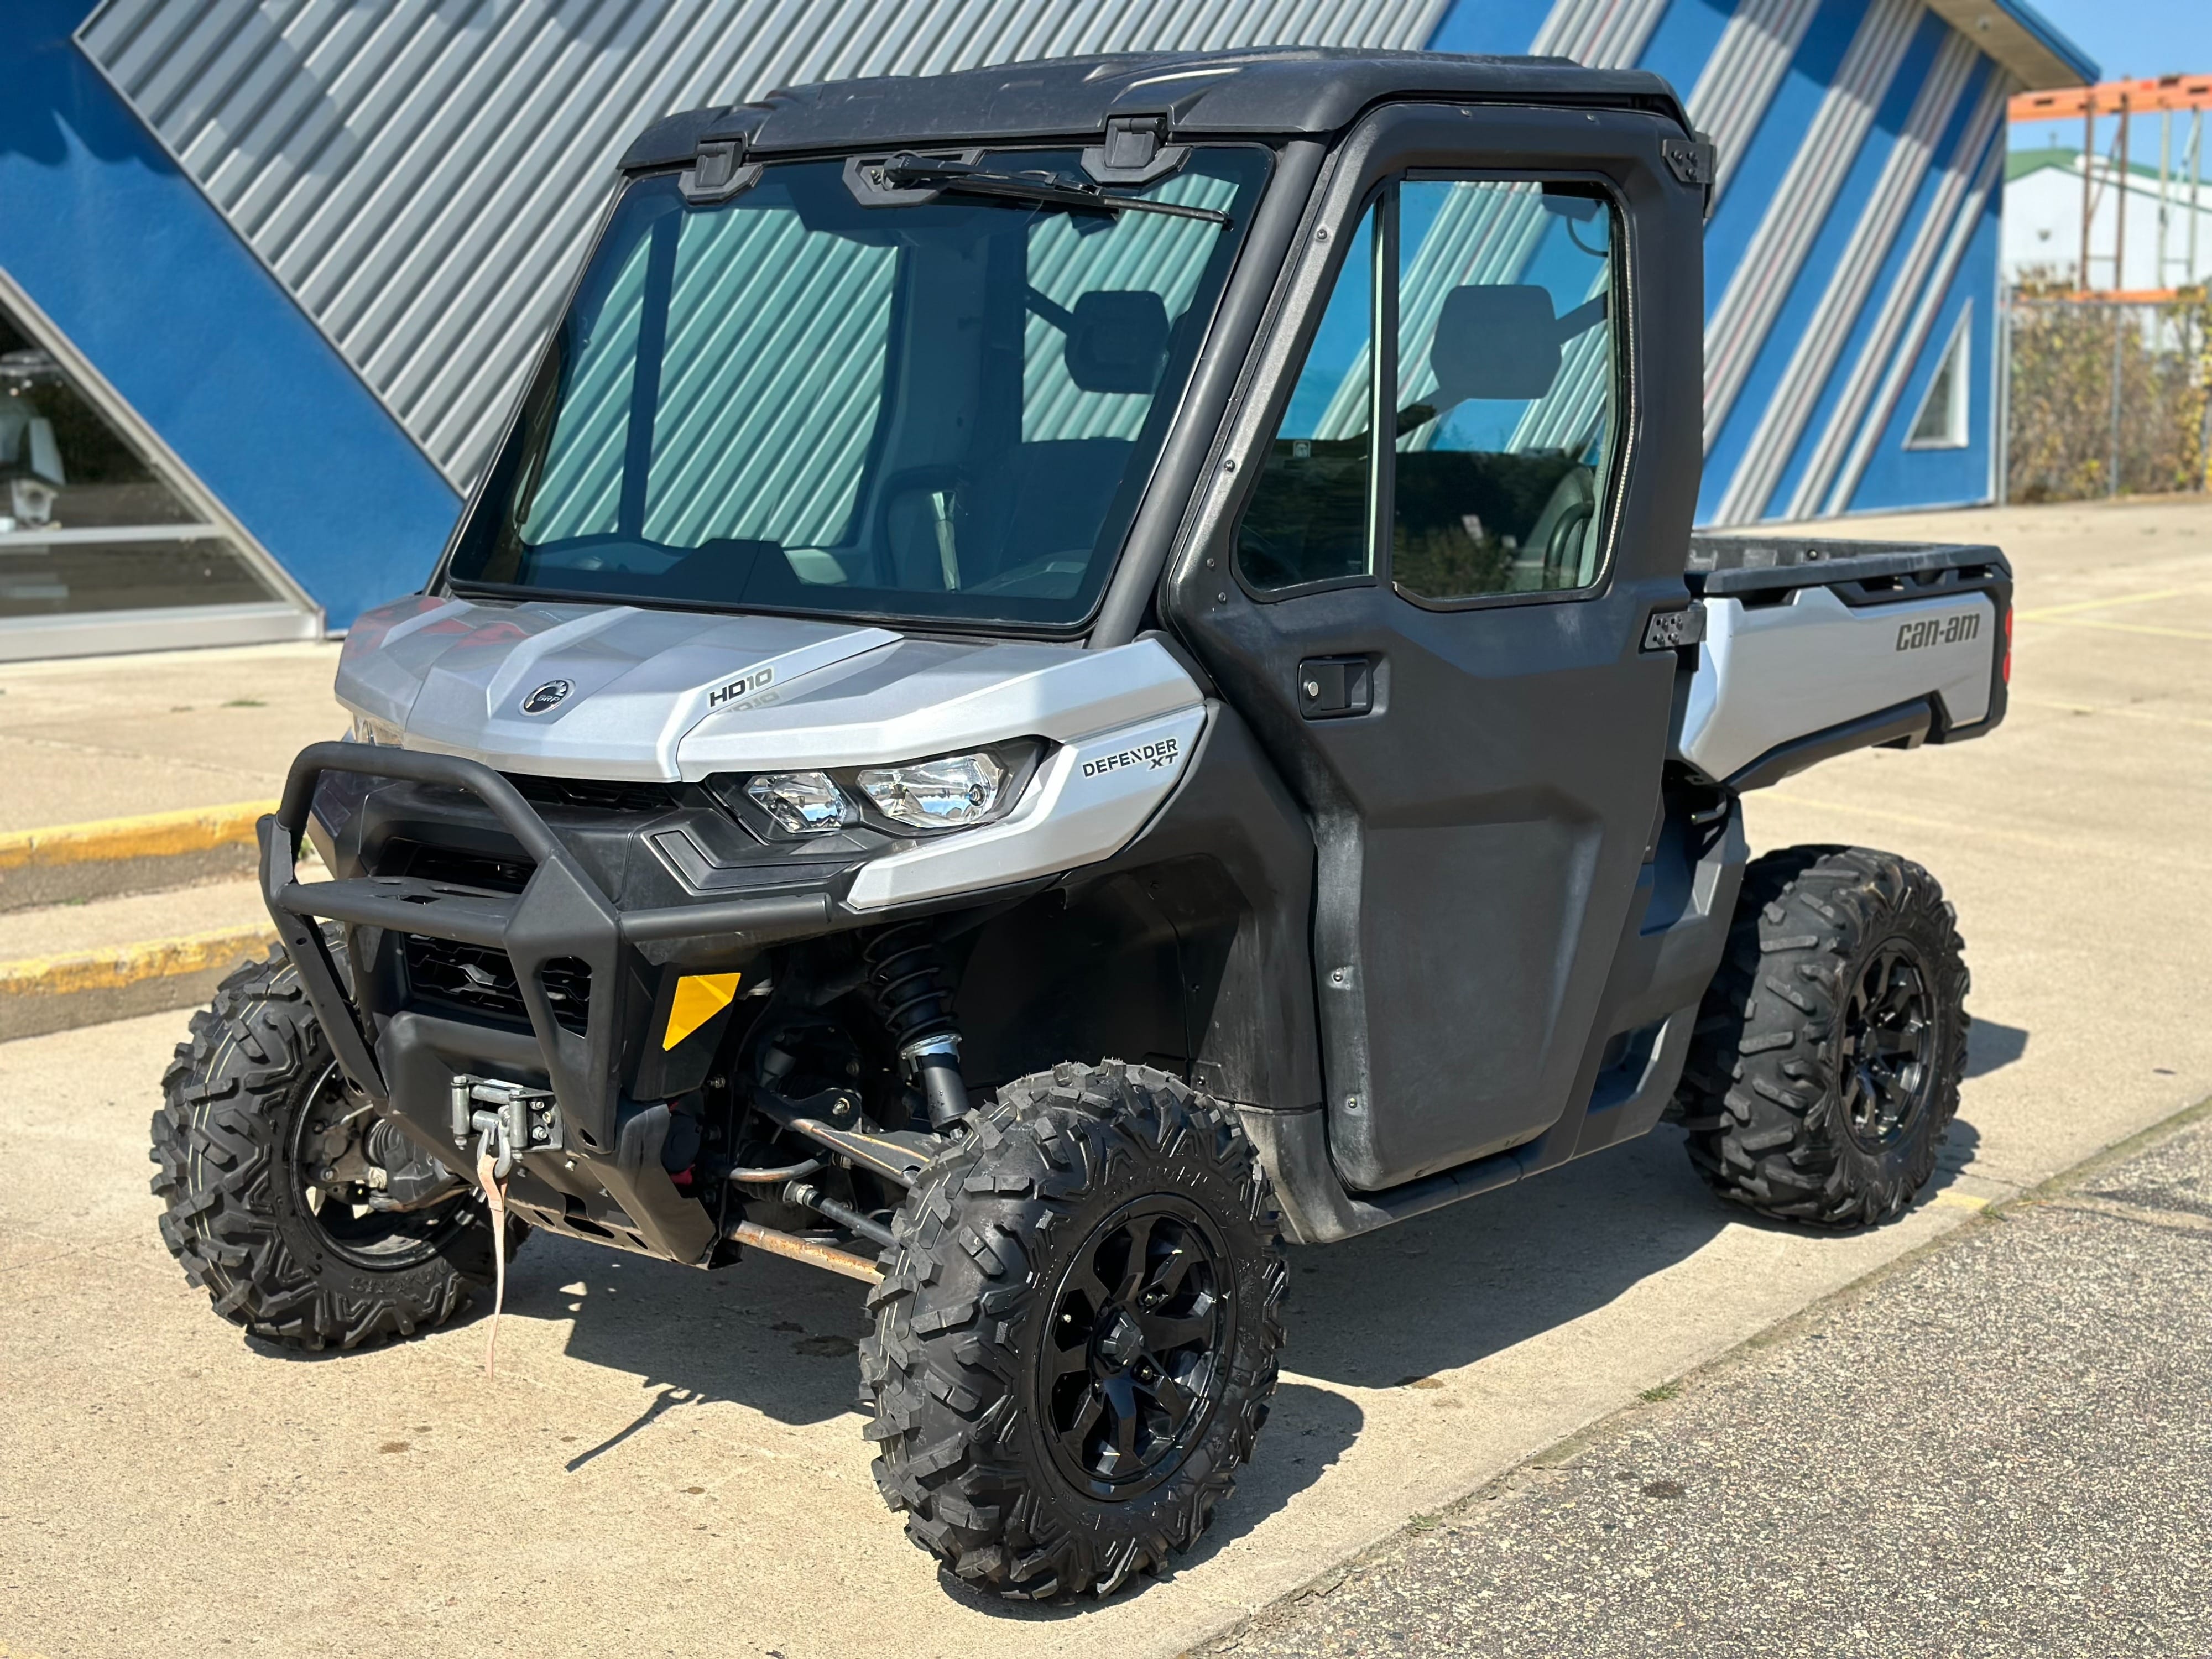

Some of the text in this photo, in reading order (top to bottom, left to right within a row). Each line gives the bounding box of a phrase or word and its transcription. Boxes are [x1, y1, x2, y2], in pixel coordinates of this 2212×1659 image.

[1896, 613, 1980, 652] can-am
[709, 667, 773, 708] HD10
[1082, 738, 1178, 778] DEFENDER
[1149, 752, 1179, 771] XT
